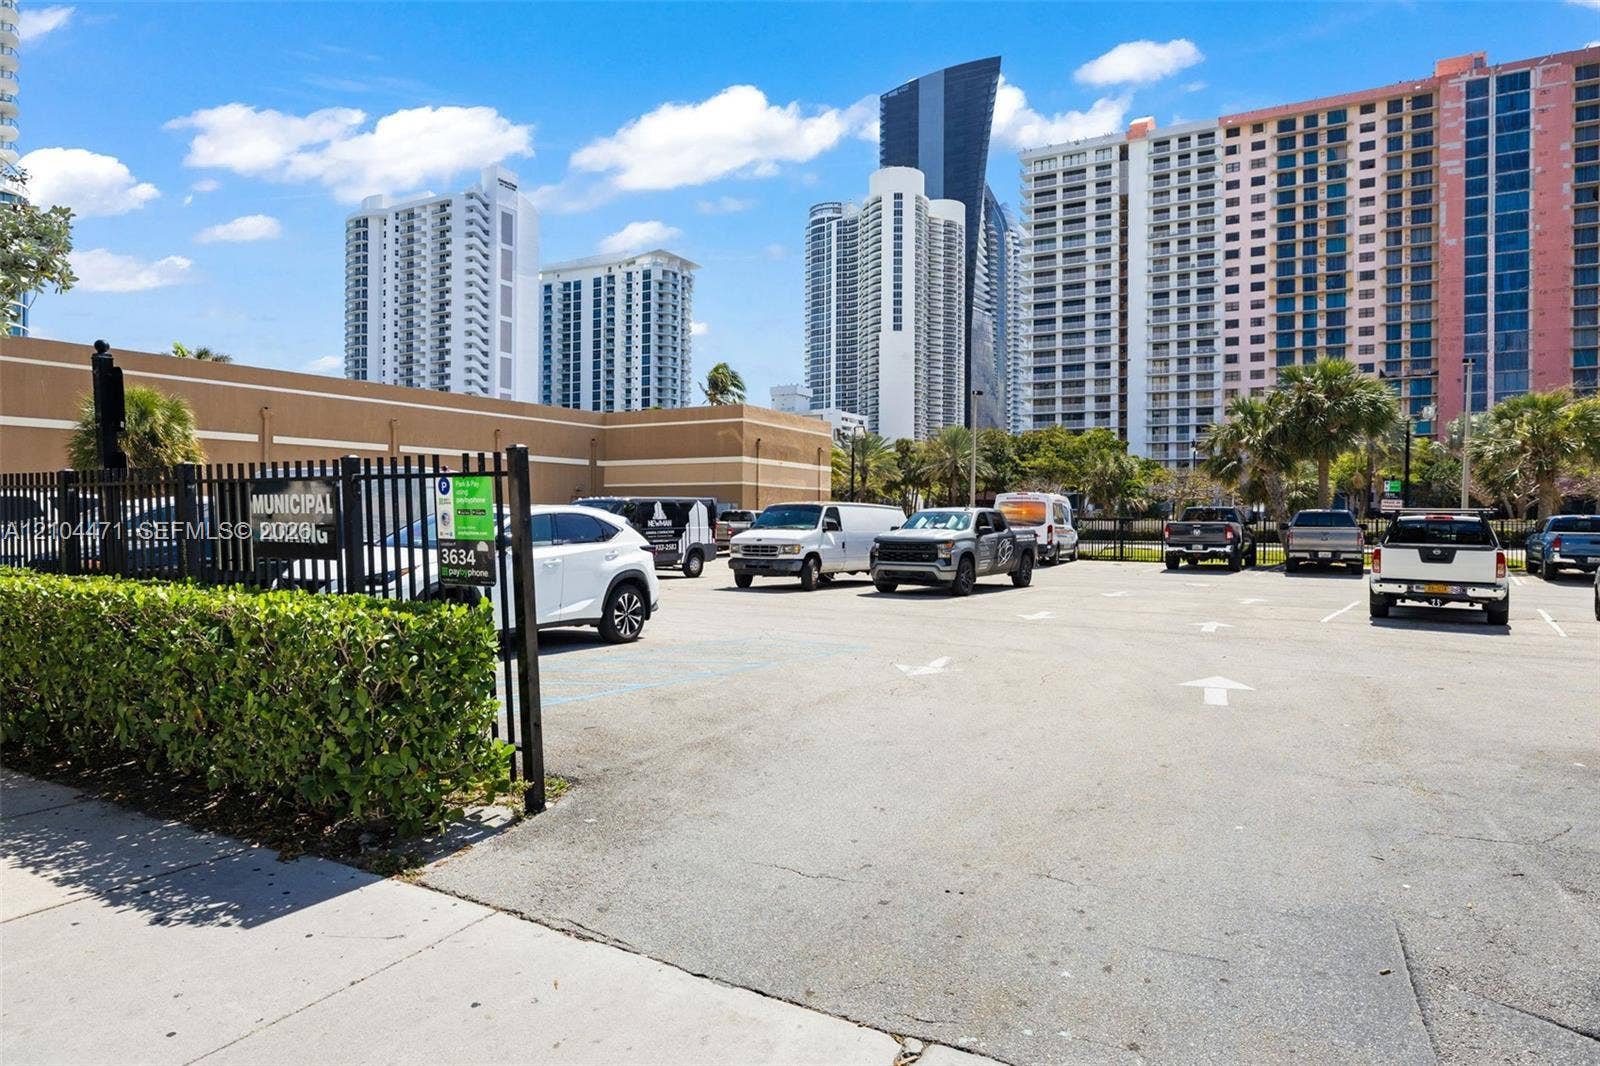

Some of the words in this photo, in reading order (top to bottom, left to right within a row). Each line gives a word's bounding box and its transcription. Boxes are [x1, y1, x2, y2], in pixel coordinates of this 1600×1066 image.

[251, 494, 333, 515] MUNICIPAL
[647, 519, 673, 527] NEWMAN
[441, 548, 477, 565] 3634
[448, 567, 489, 578] paybyphone
